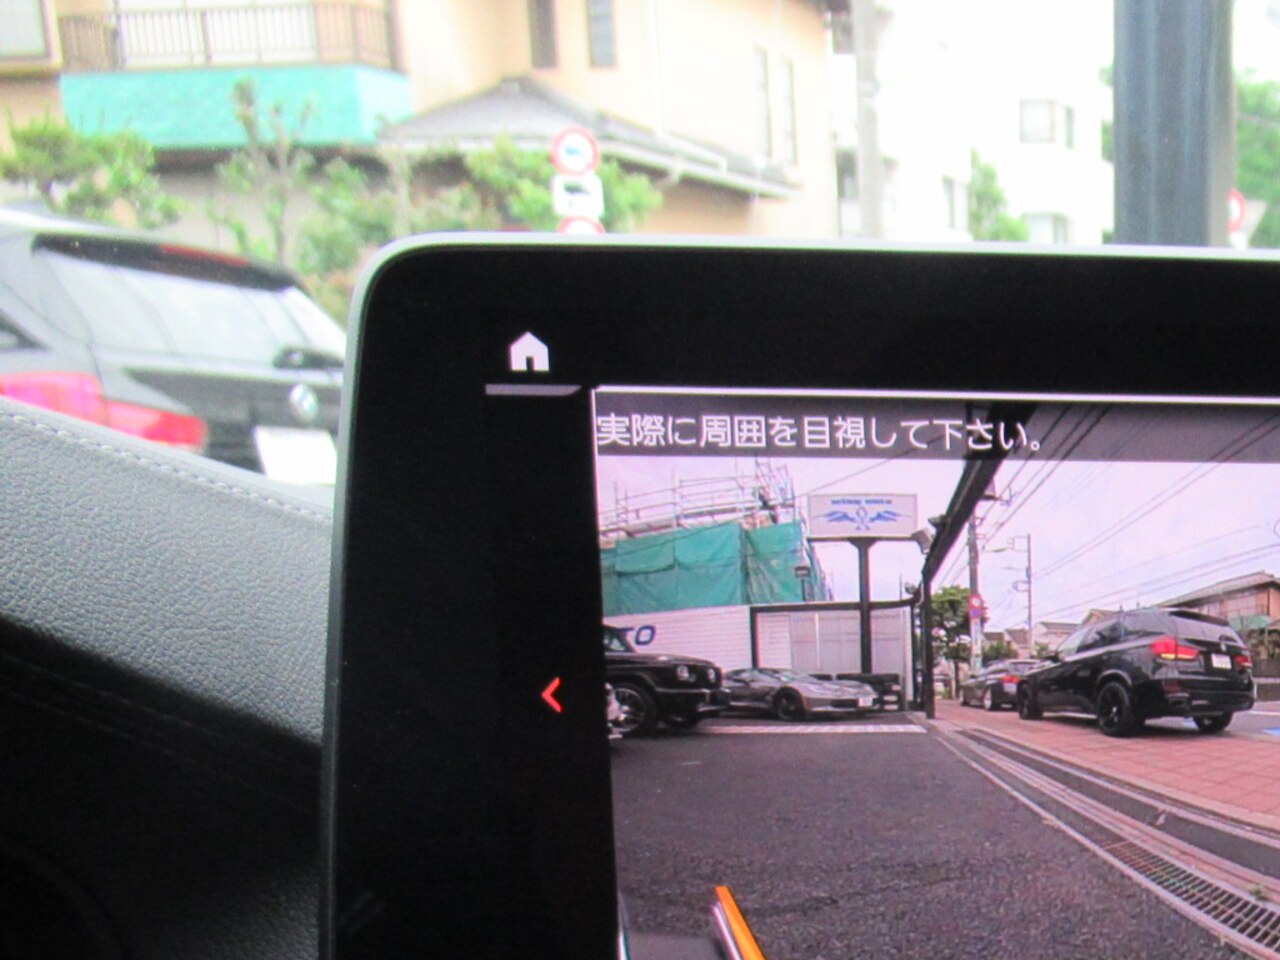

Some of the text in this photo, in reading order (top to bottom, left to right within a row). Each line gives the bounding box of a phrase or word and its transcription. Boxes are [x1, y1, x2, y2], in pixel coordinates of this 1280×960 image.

[597, 412, 1042, 451] 実際に周囲を目視して下さい。
